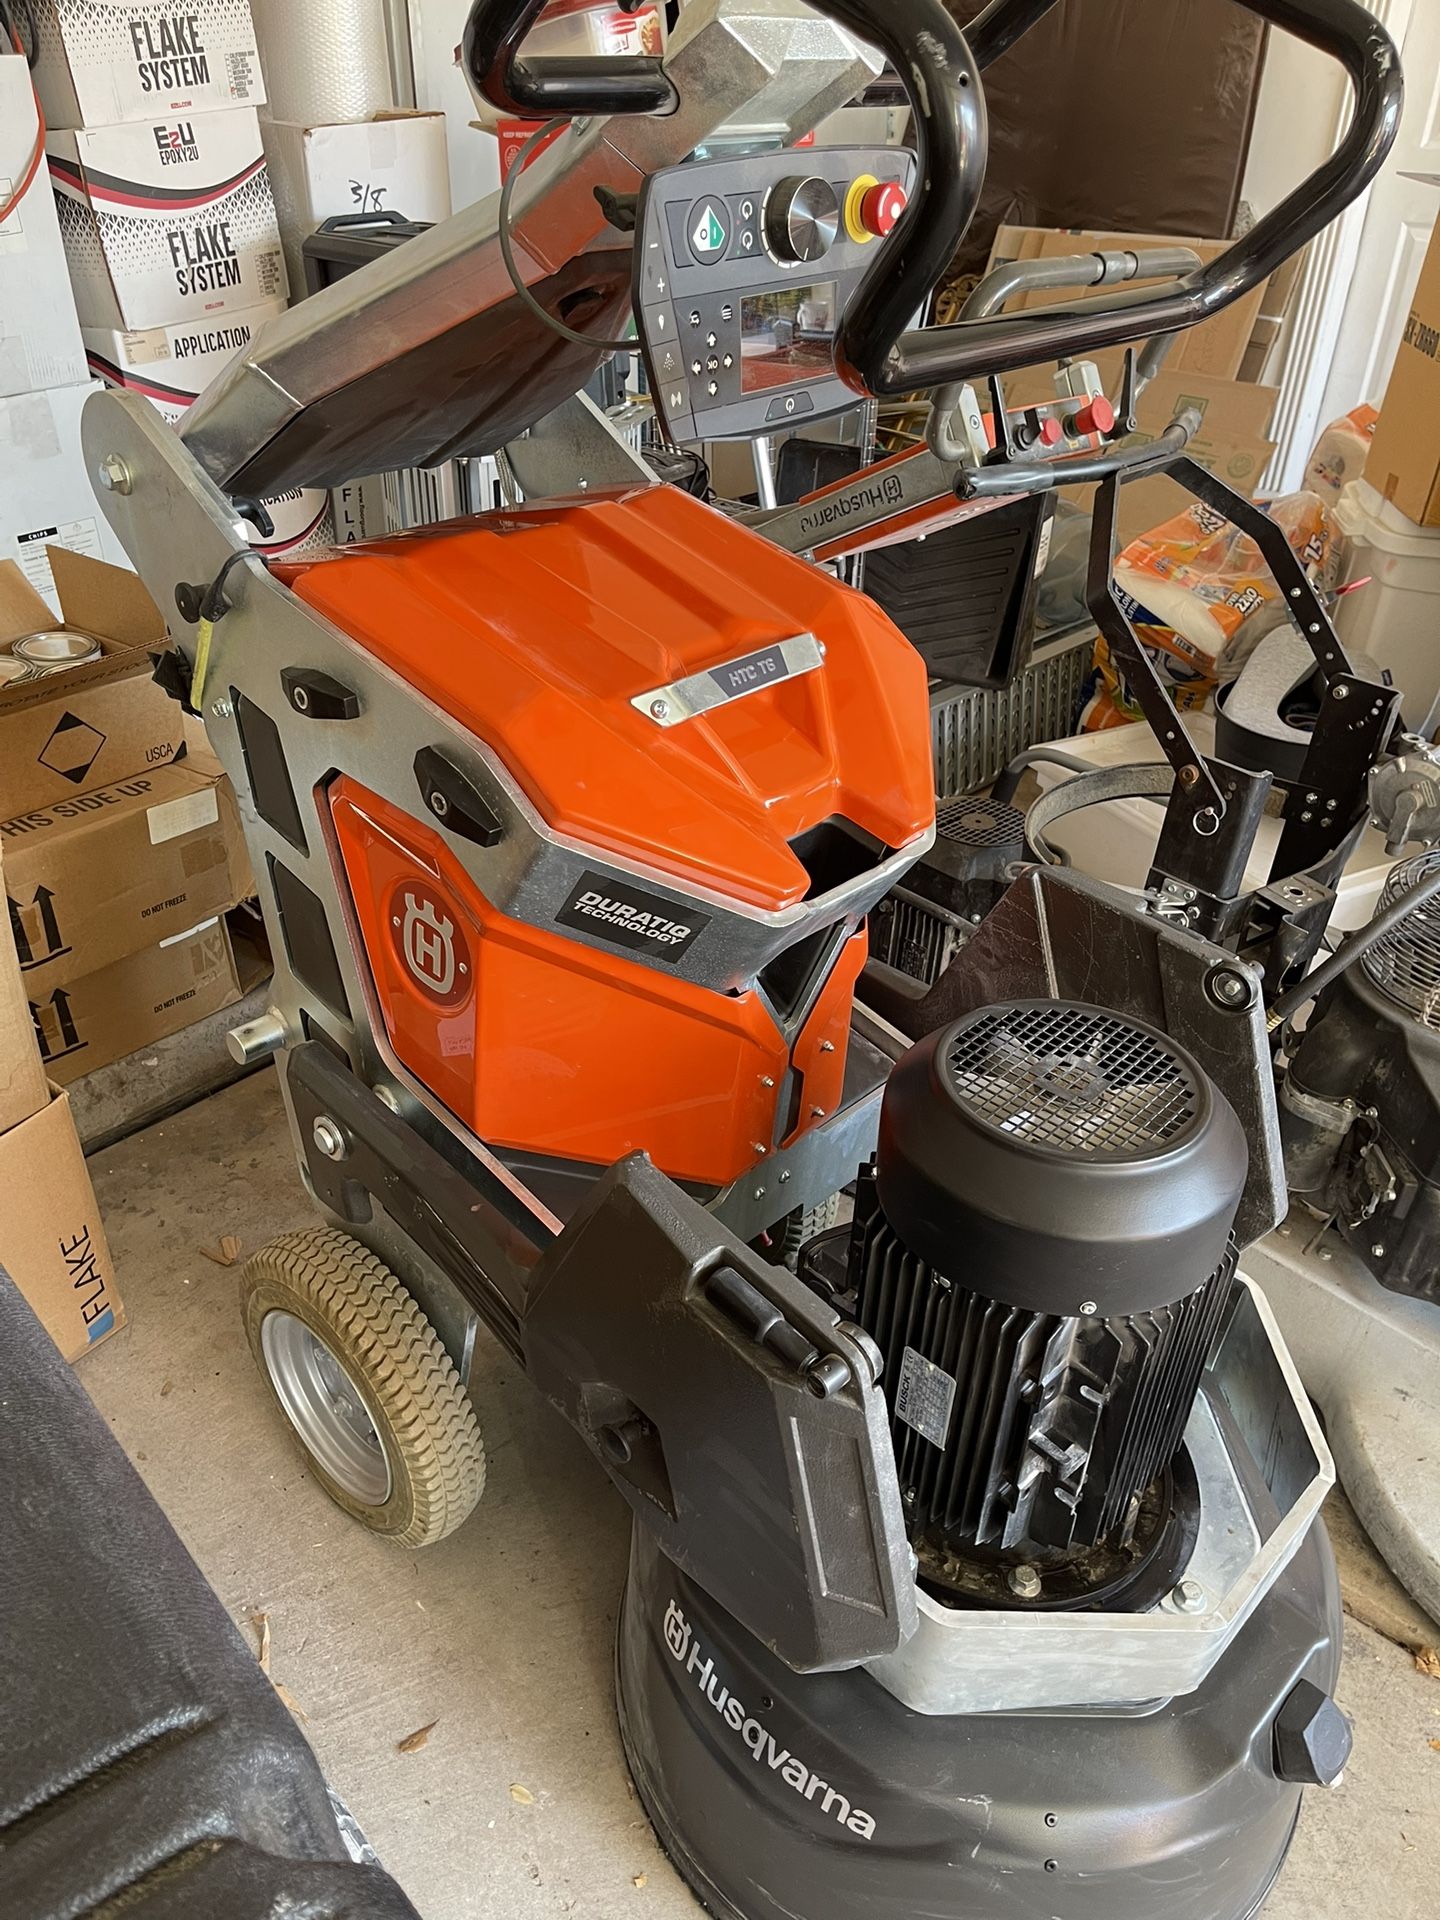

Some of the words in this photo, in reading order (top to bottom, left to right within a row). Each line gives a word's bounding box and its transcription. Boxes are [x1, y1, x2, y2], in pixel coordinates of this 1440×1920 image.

[129, 15, 205, 61] FLAKE
[138, 55, 211, 92] SYSTEM
[159, 145, 199, 166] EPOXY2U
[348, 179, 387, 213] 3/8
[167, 222, 236, 268] FLAKE
[176, 258, 242, 296] SYSTEM
[174, 325, 251, 359] APPLICATION
[801, 484, 883, 533] Husqvarna
[728, 664, 757, 687] HTC
[757, 657, 776, 674] T6
[146, 742, 174, 763] USCA
[0, 813, 54, 840] HIS
[52, 792, 121, 819] SIDE
[116, 780, 153, 797] UP
[141, 908, 151, 919] DO
[152, 902, 164, 914] NOT
[165, 892, 187, 909] FREEZE
[573, 901, 684, 945] TECHNOLOGY
[578, 891, 692, 939] DURATIQ
[153, 1004, 163, 1014] DO
[163, 998, 175, 1009] NOT
[175, 988, 197, 1004] FREEZE
[60, 1225, 110, 1324] FLAKE
[899, 1374, 911, 1413] BUSCK
[686, 1640, 877, 1841] Husqvarna
